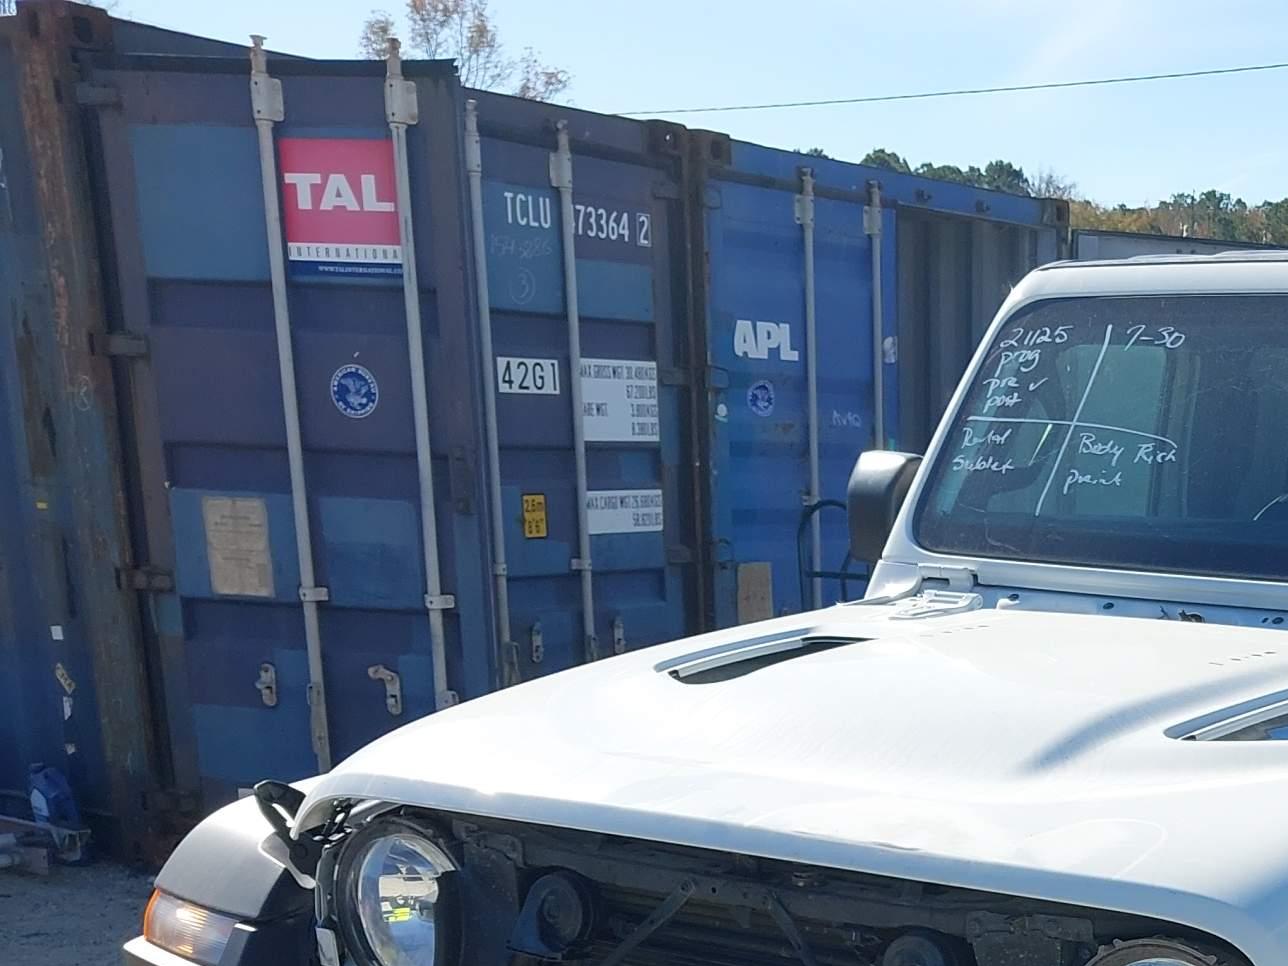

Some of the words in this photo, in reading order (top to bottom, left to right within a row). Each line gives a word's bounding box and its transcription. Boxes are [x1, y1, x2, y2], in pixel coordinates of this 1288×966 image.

[284, 172, 395, 212] TAL
[504, 192, 551, 229] TCLU
[572, 203, 629, 242] 73364
[638, 215, 650, 244] 2
[288, 246, 399, 259] INTERNATIONA
[734, 319, 799, 361] APL
[502, 360, 558, 391] 42G1
[1079, 432, 1124, 467] Body
